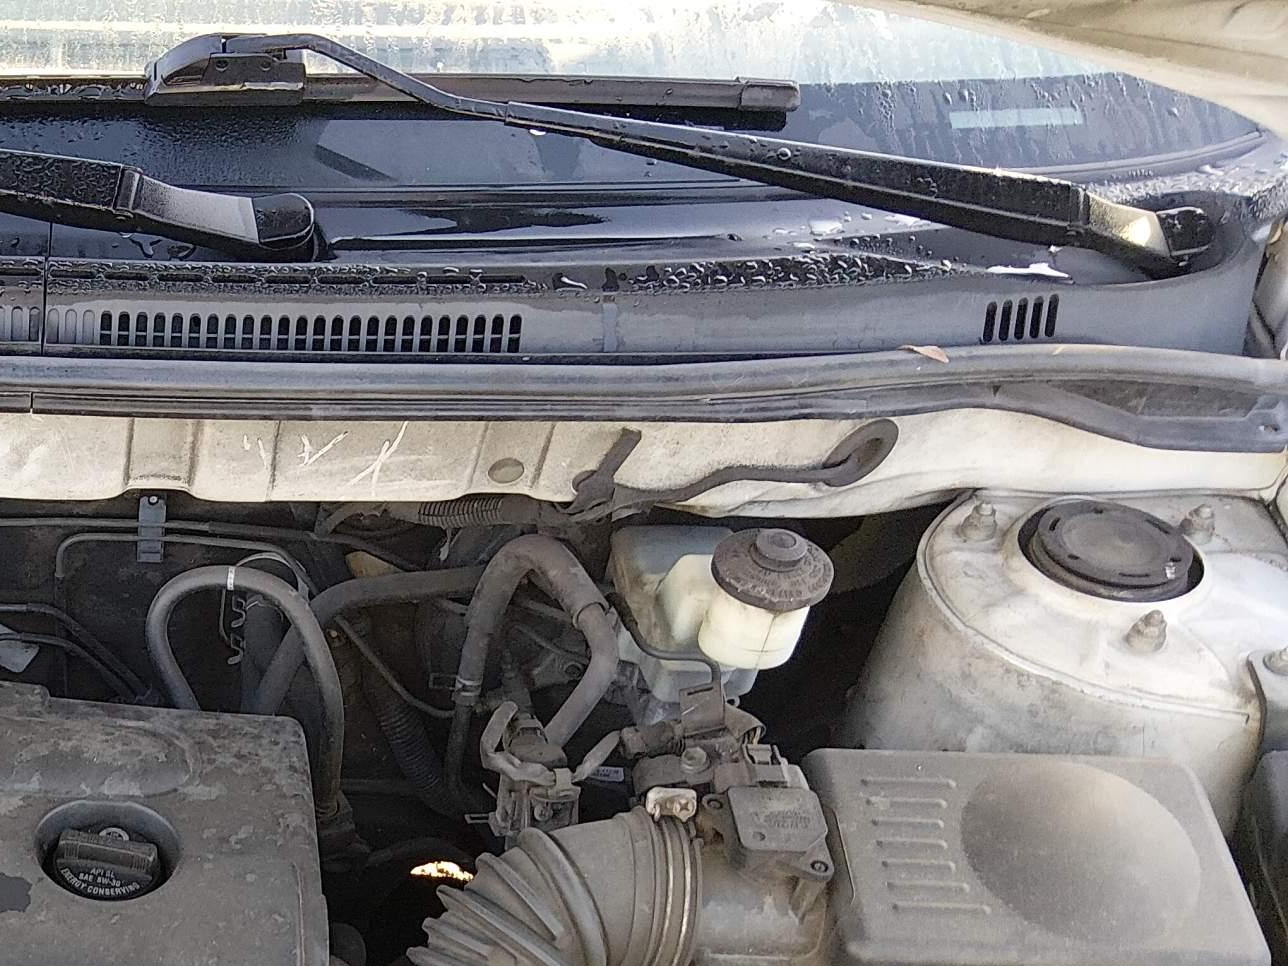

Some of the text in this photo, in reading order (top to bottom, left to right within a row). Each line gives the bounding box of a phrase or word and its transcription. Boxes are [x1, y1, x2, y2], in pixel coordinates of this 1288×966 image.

[61, 868, 140, 896] ENERGY CONSERVING
[78, 872, 94, 882] SAE
